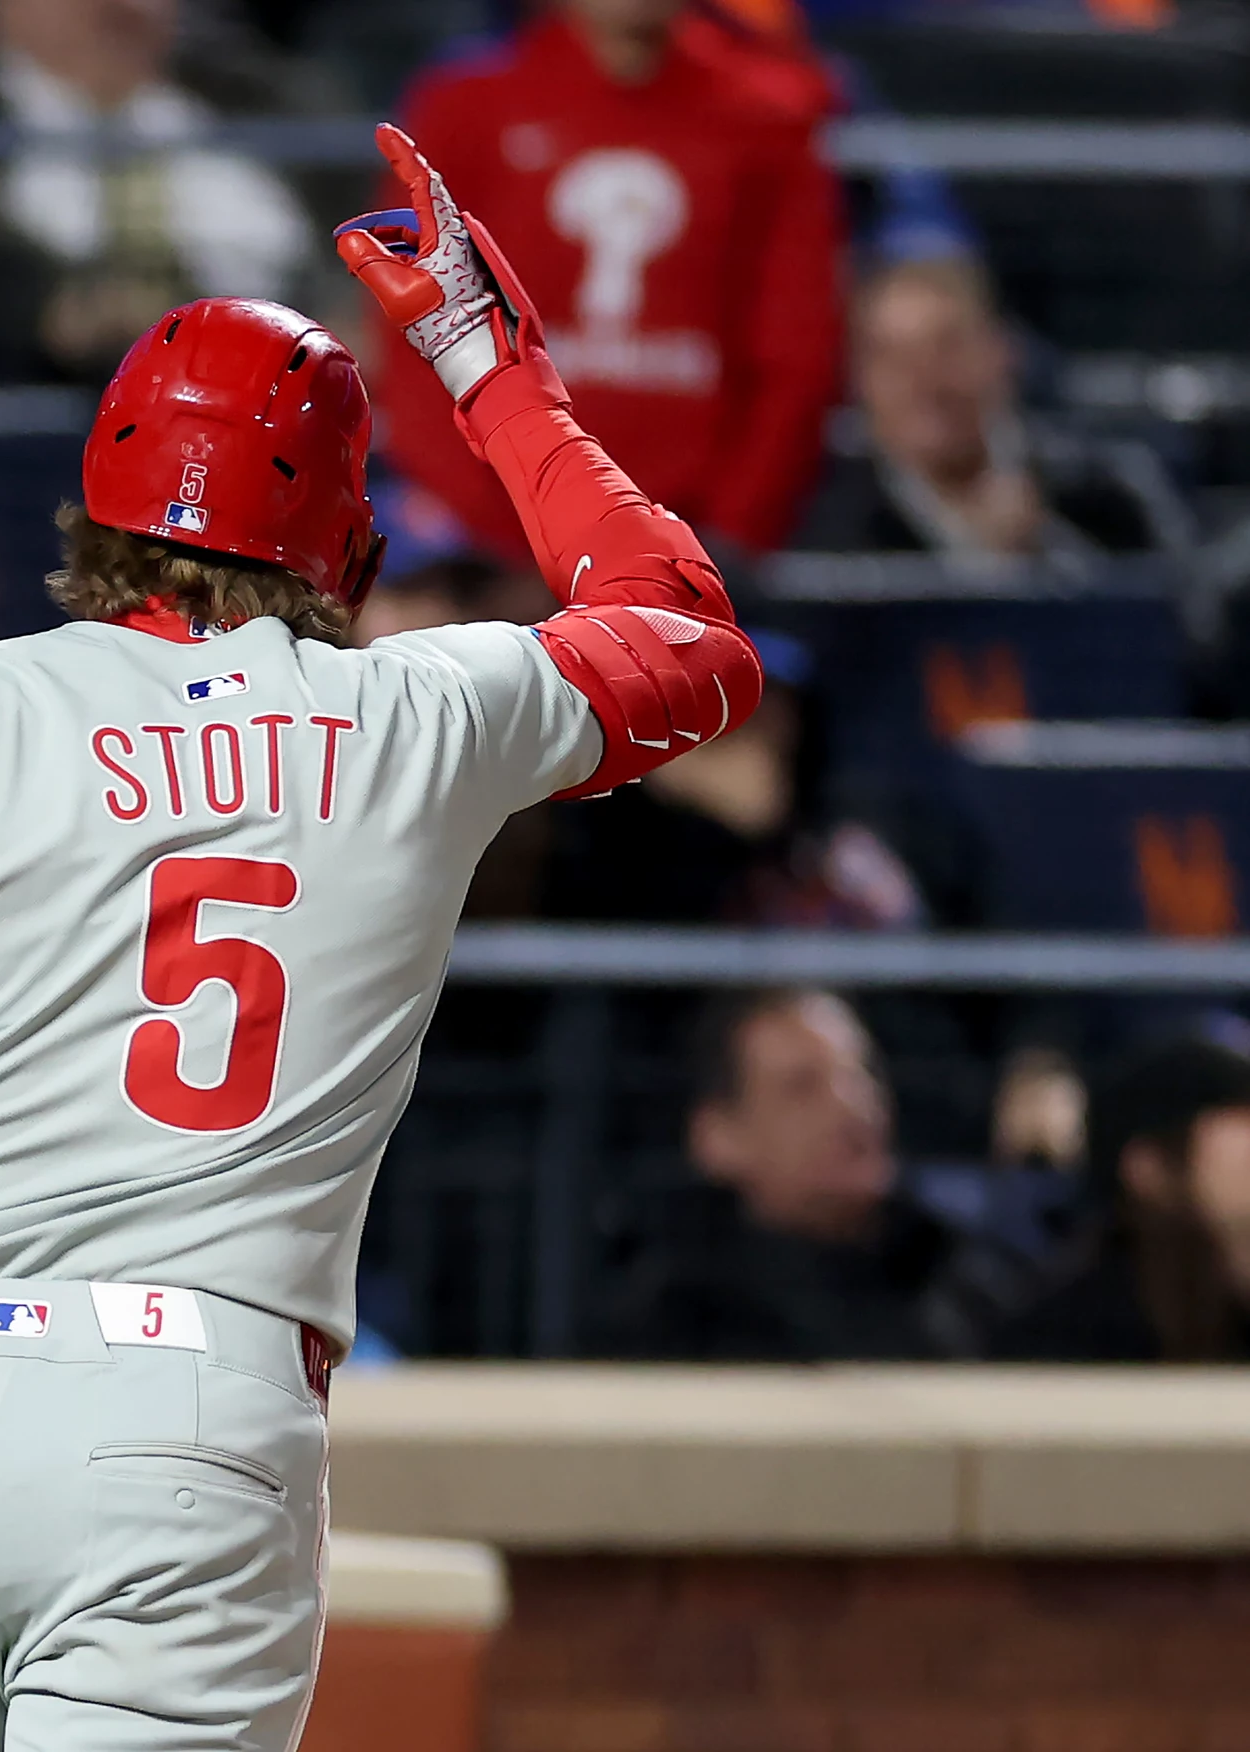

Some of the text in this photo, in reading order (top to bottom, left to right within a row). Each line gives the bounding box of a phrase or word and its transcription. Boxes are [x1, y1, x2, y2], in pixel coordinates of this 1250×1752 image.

[179, 463, 208, 504] 5
[89, 712, 355, 823] STOTT
[120, 854, 301, 1135] 5
[141, 1292, 163, 1338] 5
